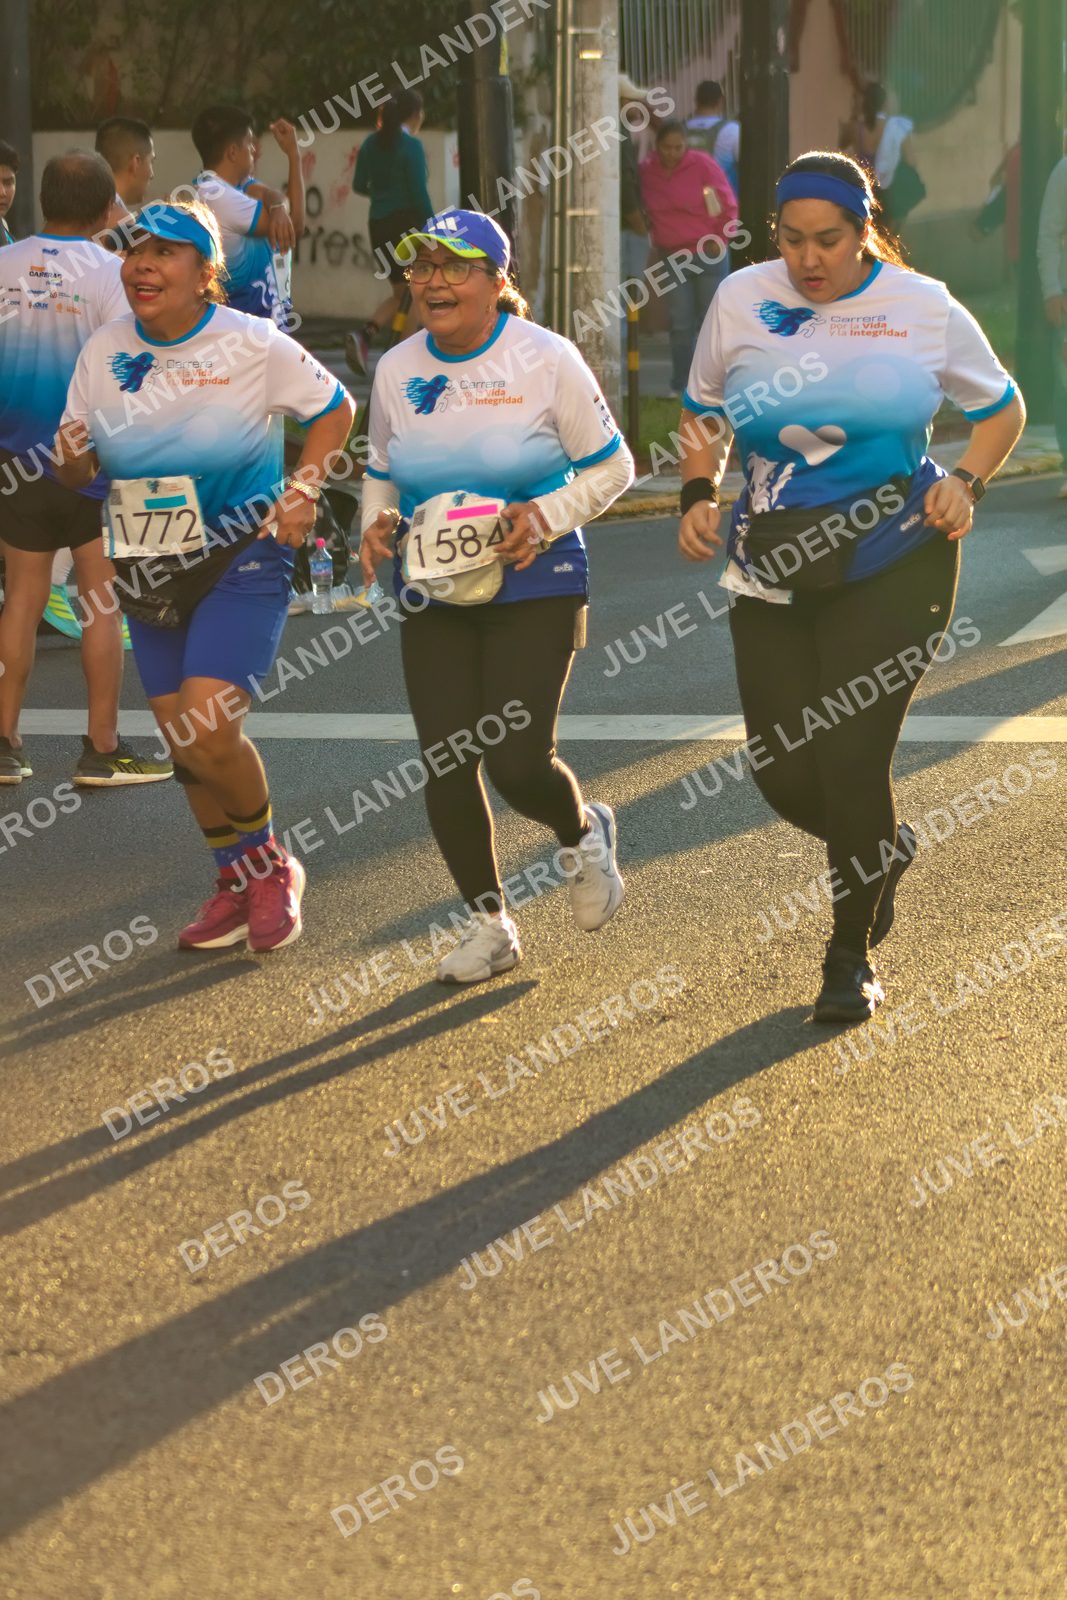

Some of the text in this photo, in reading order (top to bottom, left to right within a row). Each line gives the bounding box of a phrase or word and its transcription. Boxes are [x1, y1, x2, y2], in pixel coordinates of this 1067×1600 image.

[830, 314, 886, 322] Carrera
[830, 324, 848, 332] por
[850, 329, 908, 338] Integridad
[460, 380, 506, 389] Carrera
[476, 396, 523, 406] Integridad
[115, 508, 201, 546] 1772
[414, 517, 504, 568] 1584
